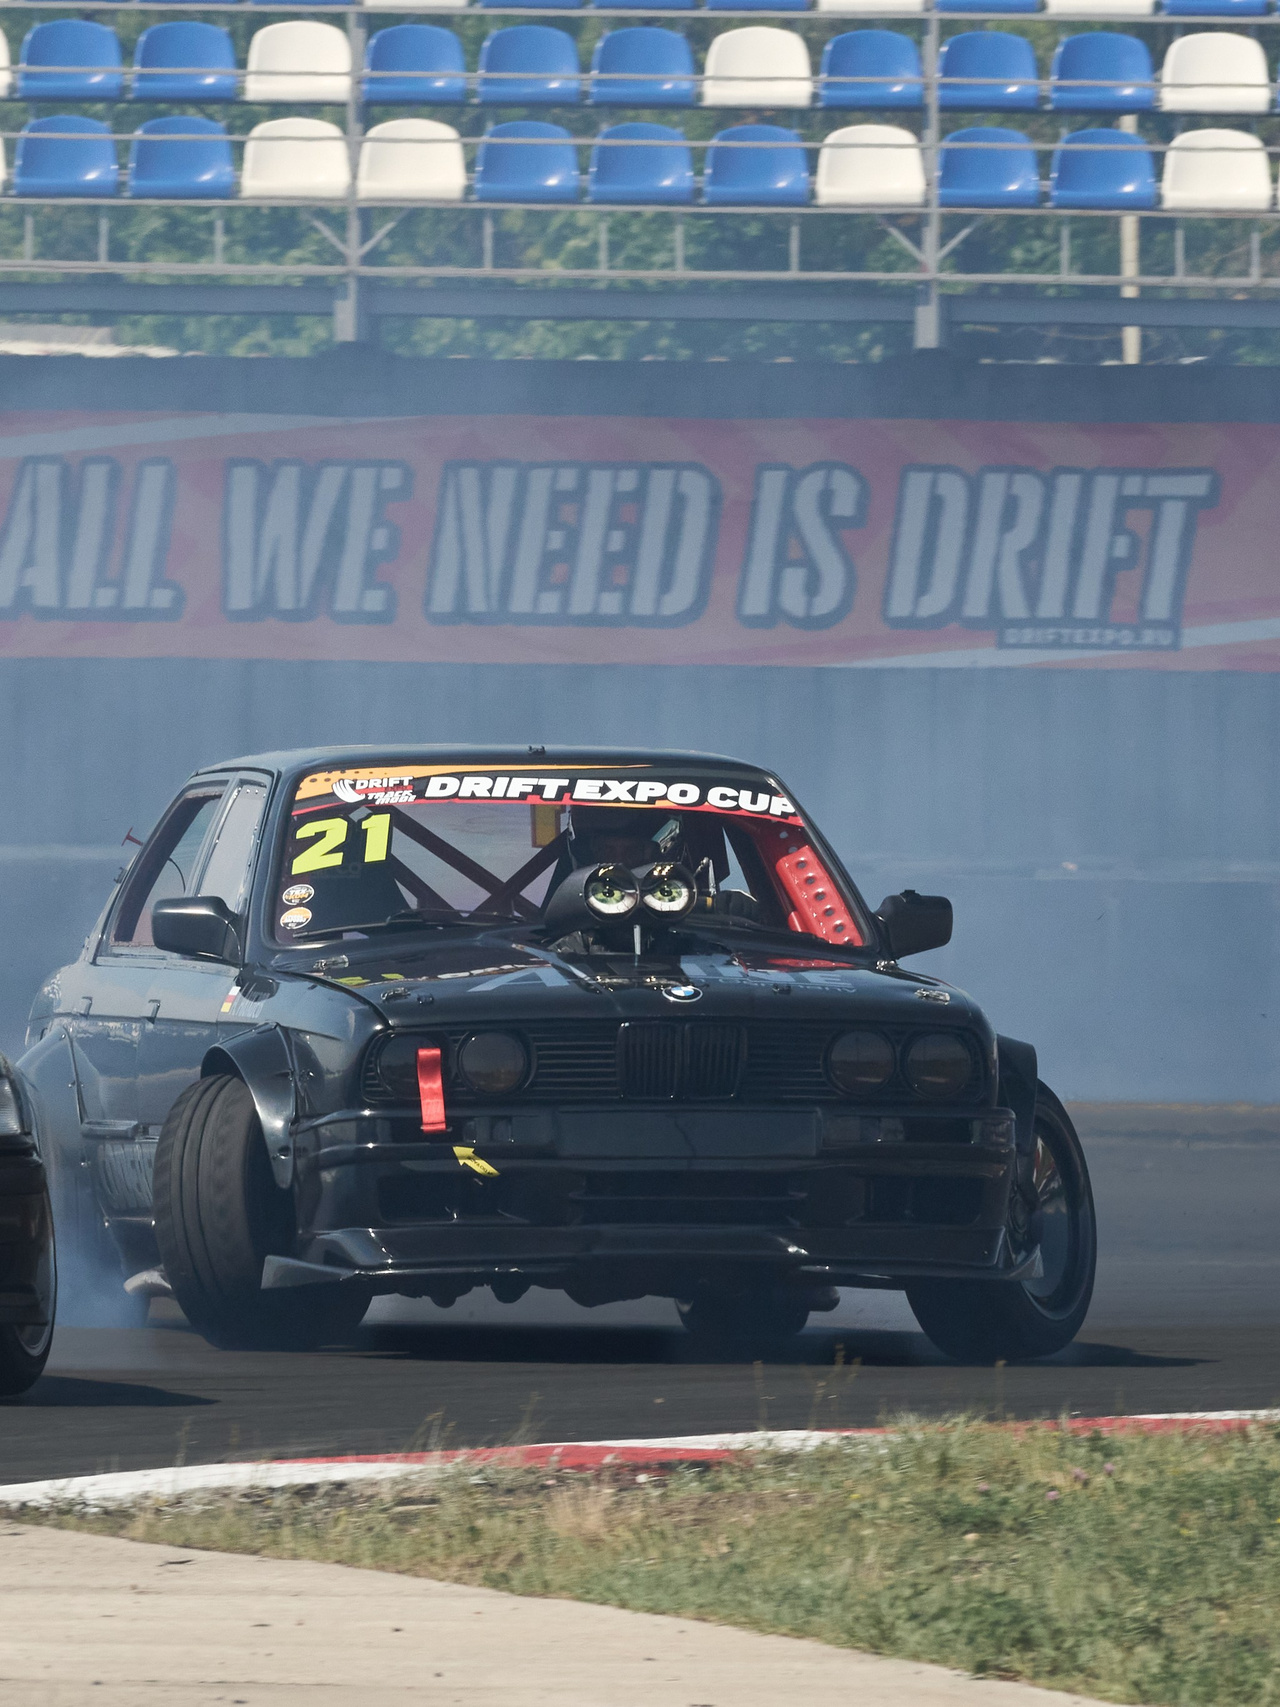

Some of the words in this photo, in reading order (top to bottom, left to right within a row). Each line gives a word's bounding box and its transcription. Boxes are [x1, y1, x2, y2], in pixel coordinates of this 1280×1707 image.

[228, 466, 403, 611] WE
[430, 467, 712, 616] NEED
[741, 468, 861, 617] IS
[887, 472, 1212, 621] DRIFT
[355, 776, 414, 790] DRIFT
[424, 776, 569, 800] DRIFT
[572, 779, 701, 804] EXPO
[707, 786, 796, 816] CUP
[291, 813, 391, 876] 21
